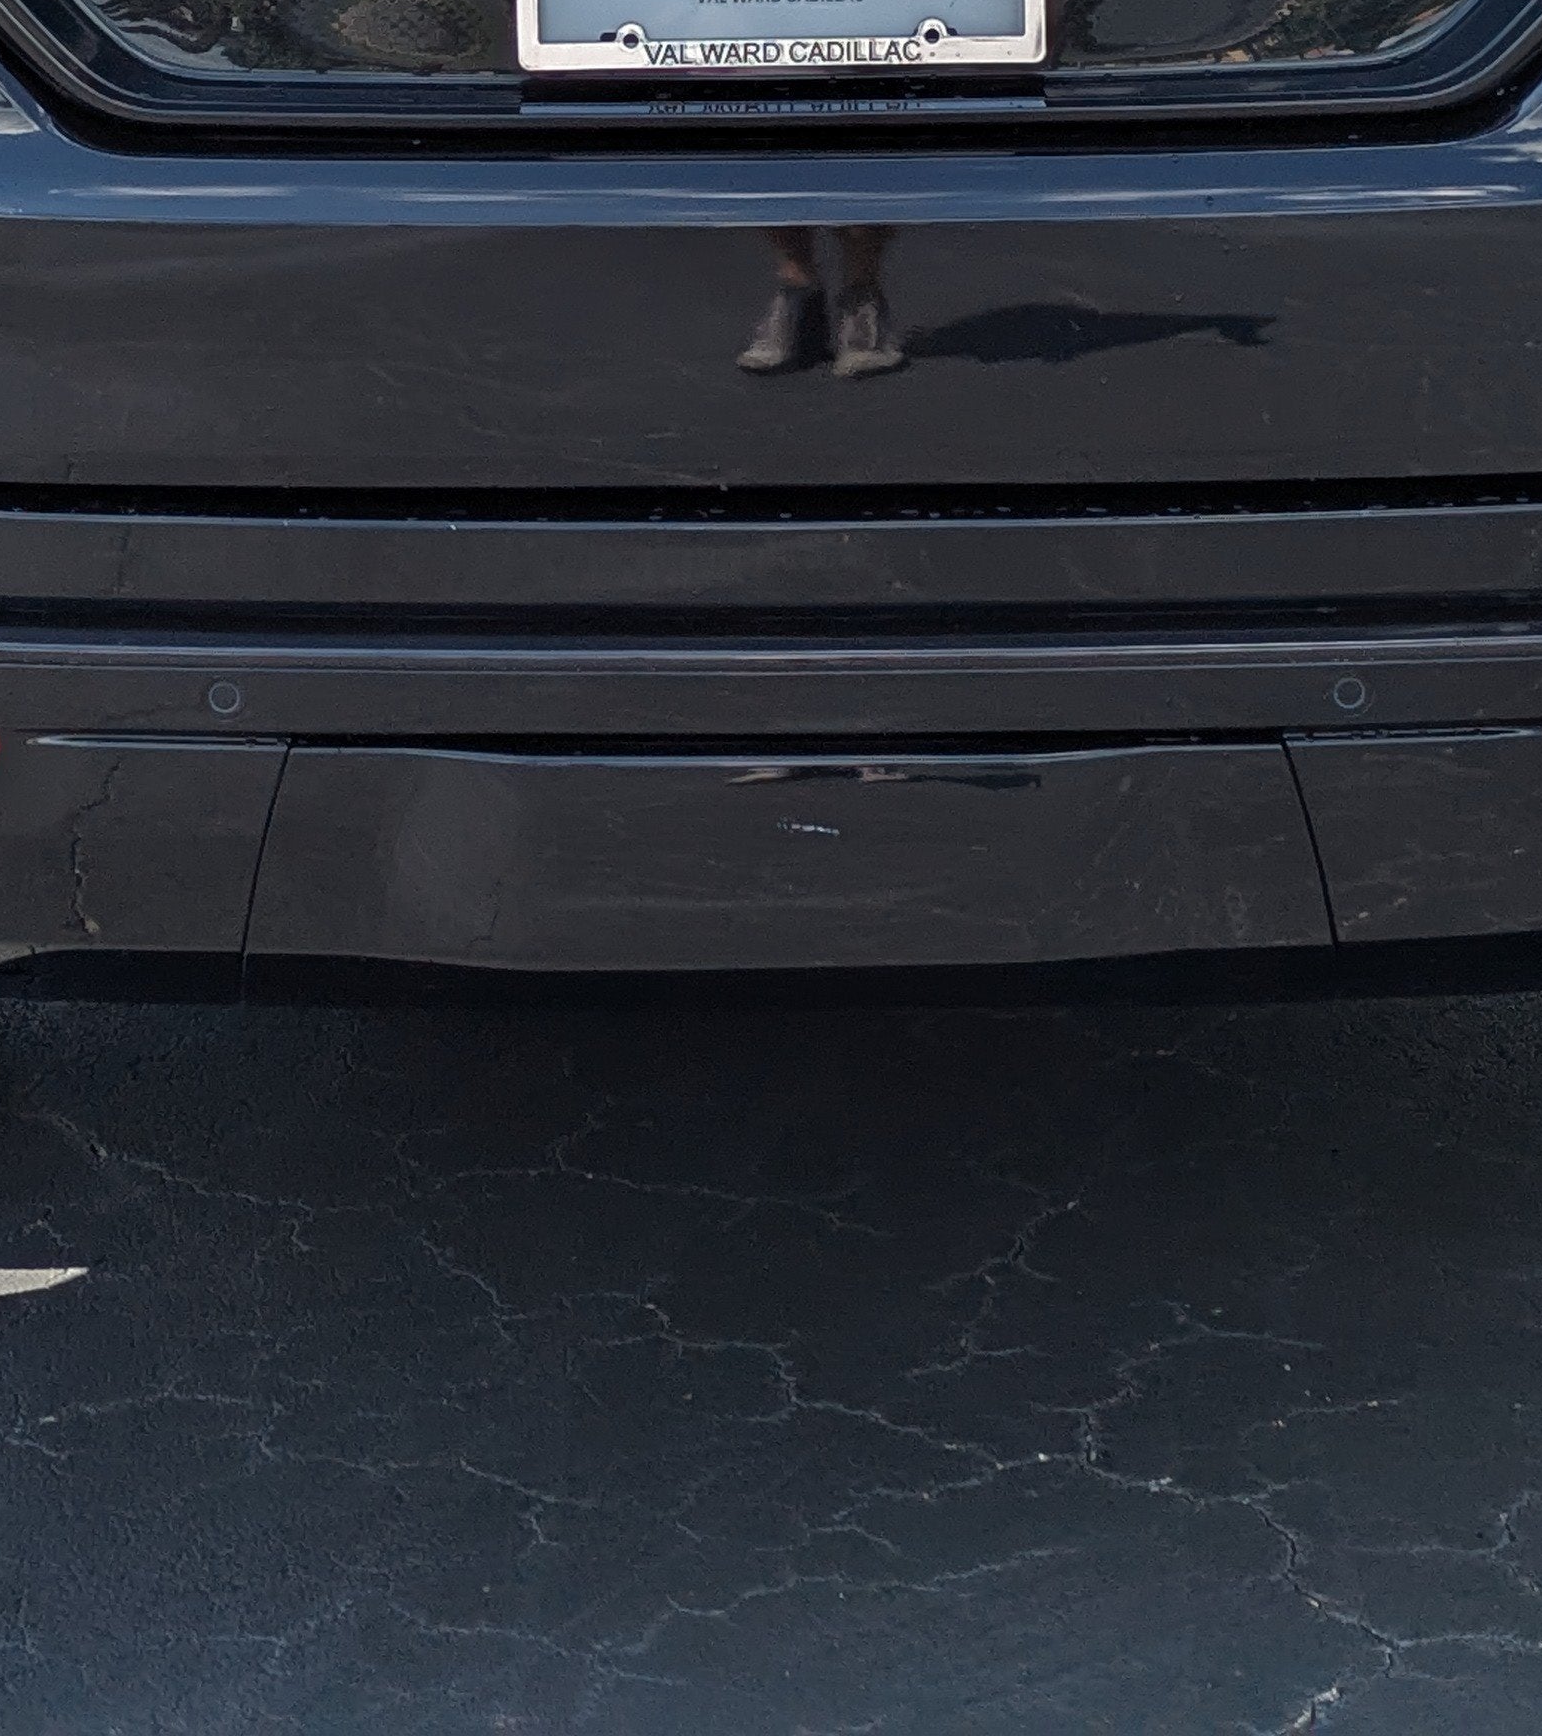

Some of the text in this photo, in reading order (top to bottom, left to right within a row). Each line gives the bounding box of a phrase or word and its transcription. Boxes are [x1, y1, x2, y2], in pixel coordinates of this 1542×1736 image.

[644, 40, 921, 64] VAL WARD CADILLAC
